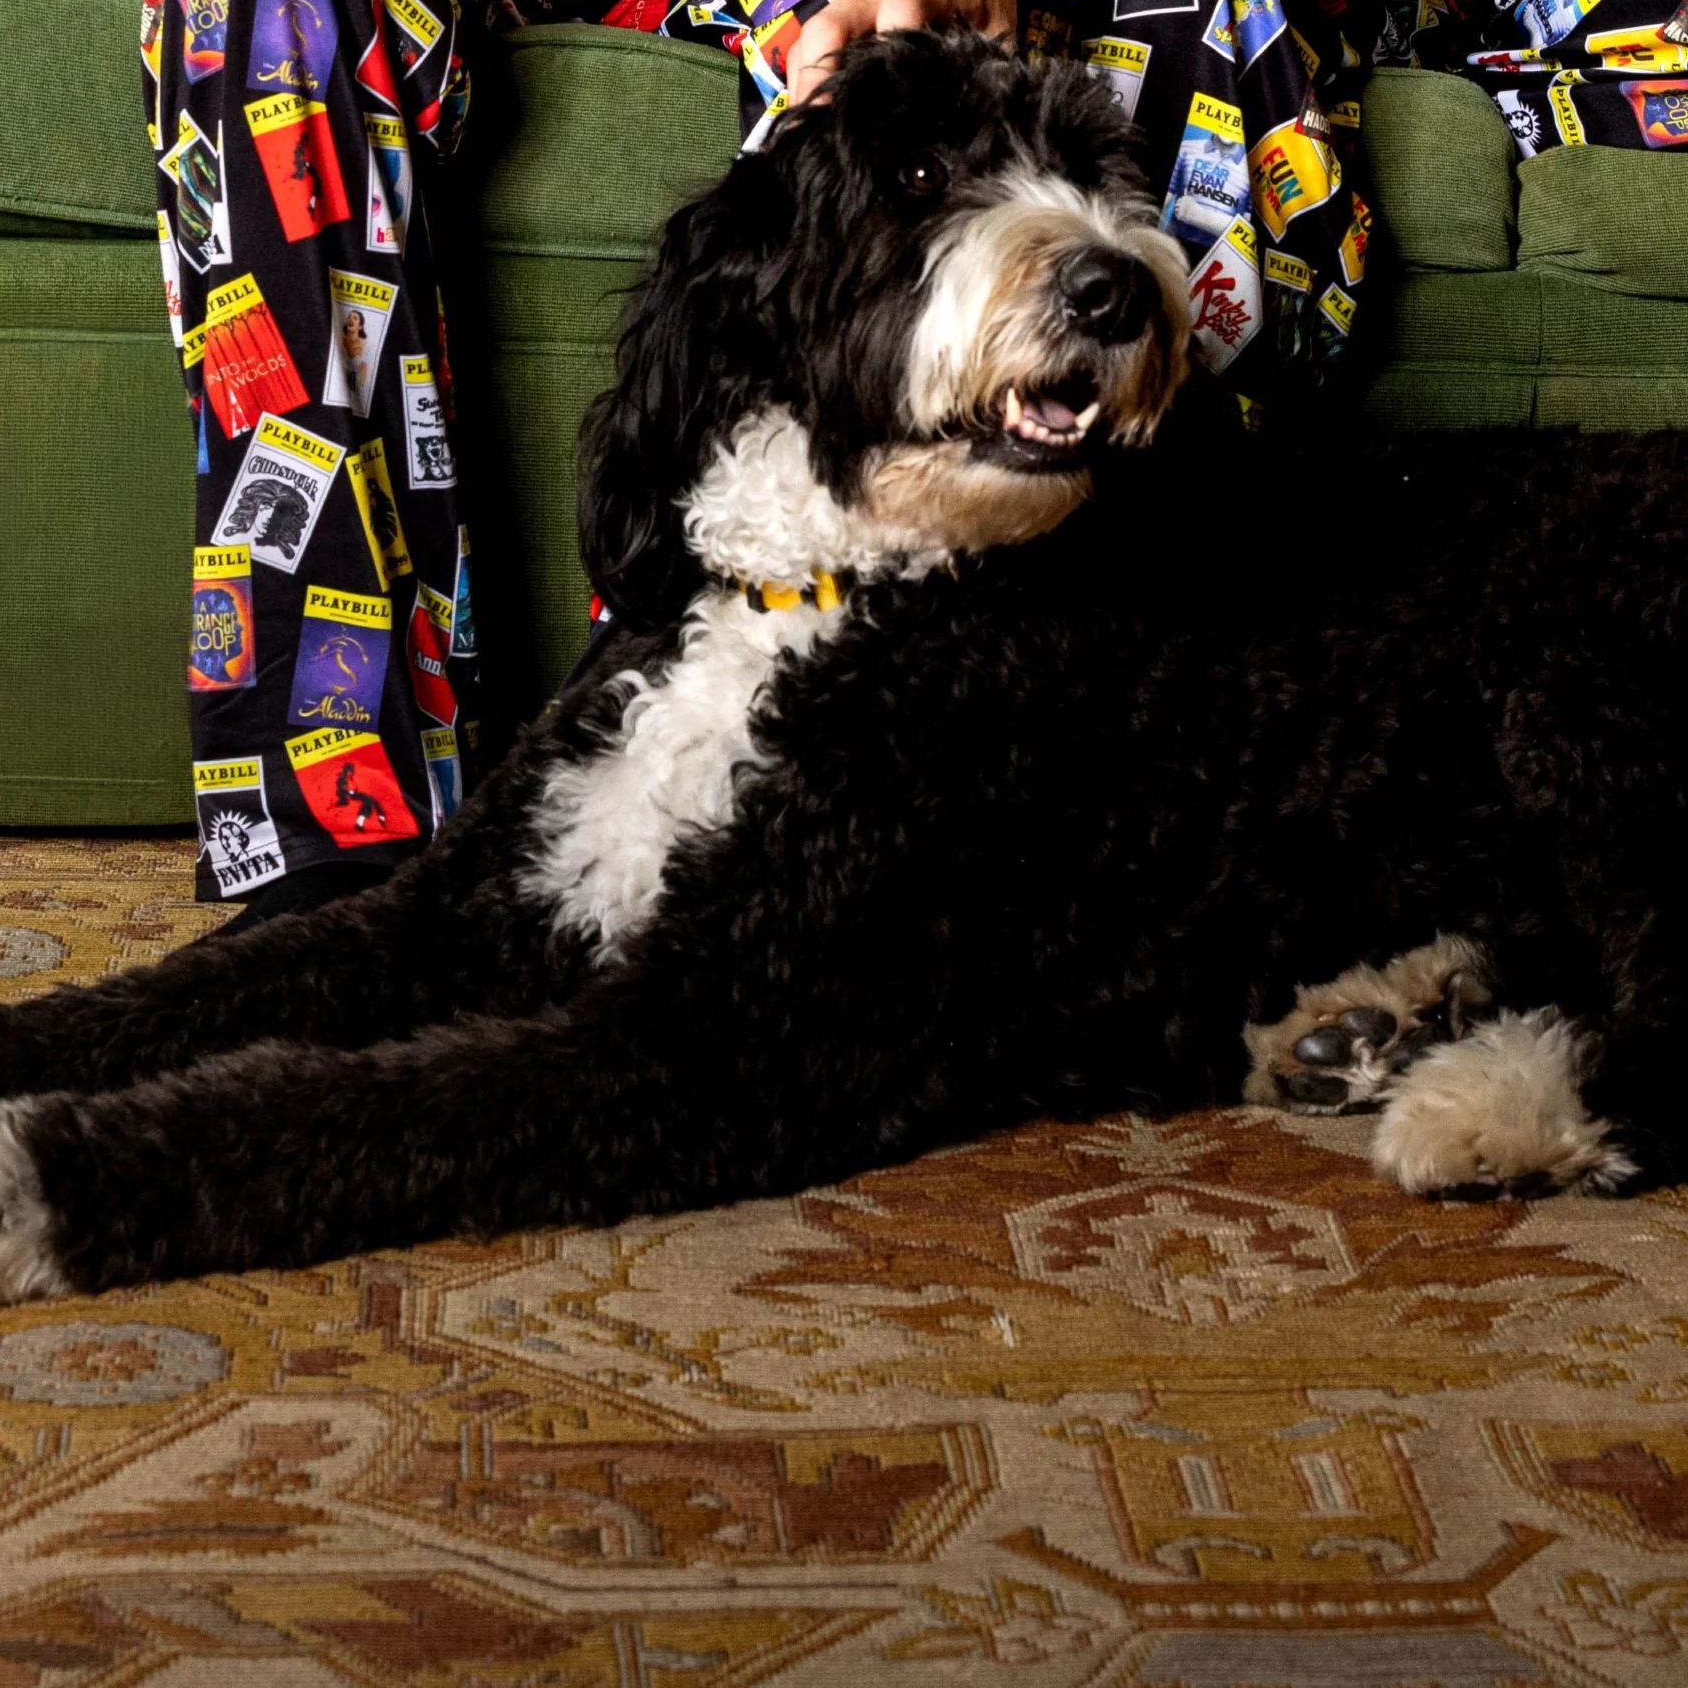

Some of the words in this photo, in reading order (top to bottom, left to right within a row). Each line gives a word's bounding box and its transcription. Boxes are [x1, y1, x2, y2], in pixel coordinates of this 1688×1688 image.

[1197, 102, 1242, 128] PLAYB
[1664, 96, 1685, 130] OOP
[1191, 170, 1225, 191] EVAN
[1194, 159, 1230, 181] DEAR
[1262, 146, 1304, 205] FUN
[1187, 182, 1241, 209] HANSEN
[262, 423, 335, 463] PLAYBILL
[309, 593, 389, 618] PLAYBILL
[198, 766, 257, 781] AYBILL
[216, 851, 280, 888] EVITA
